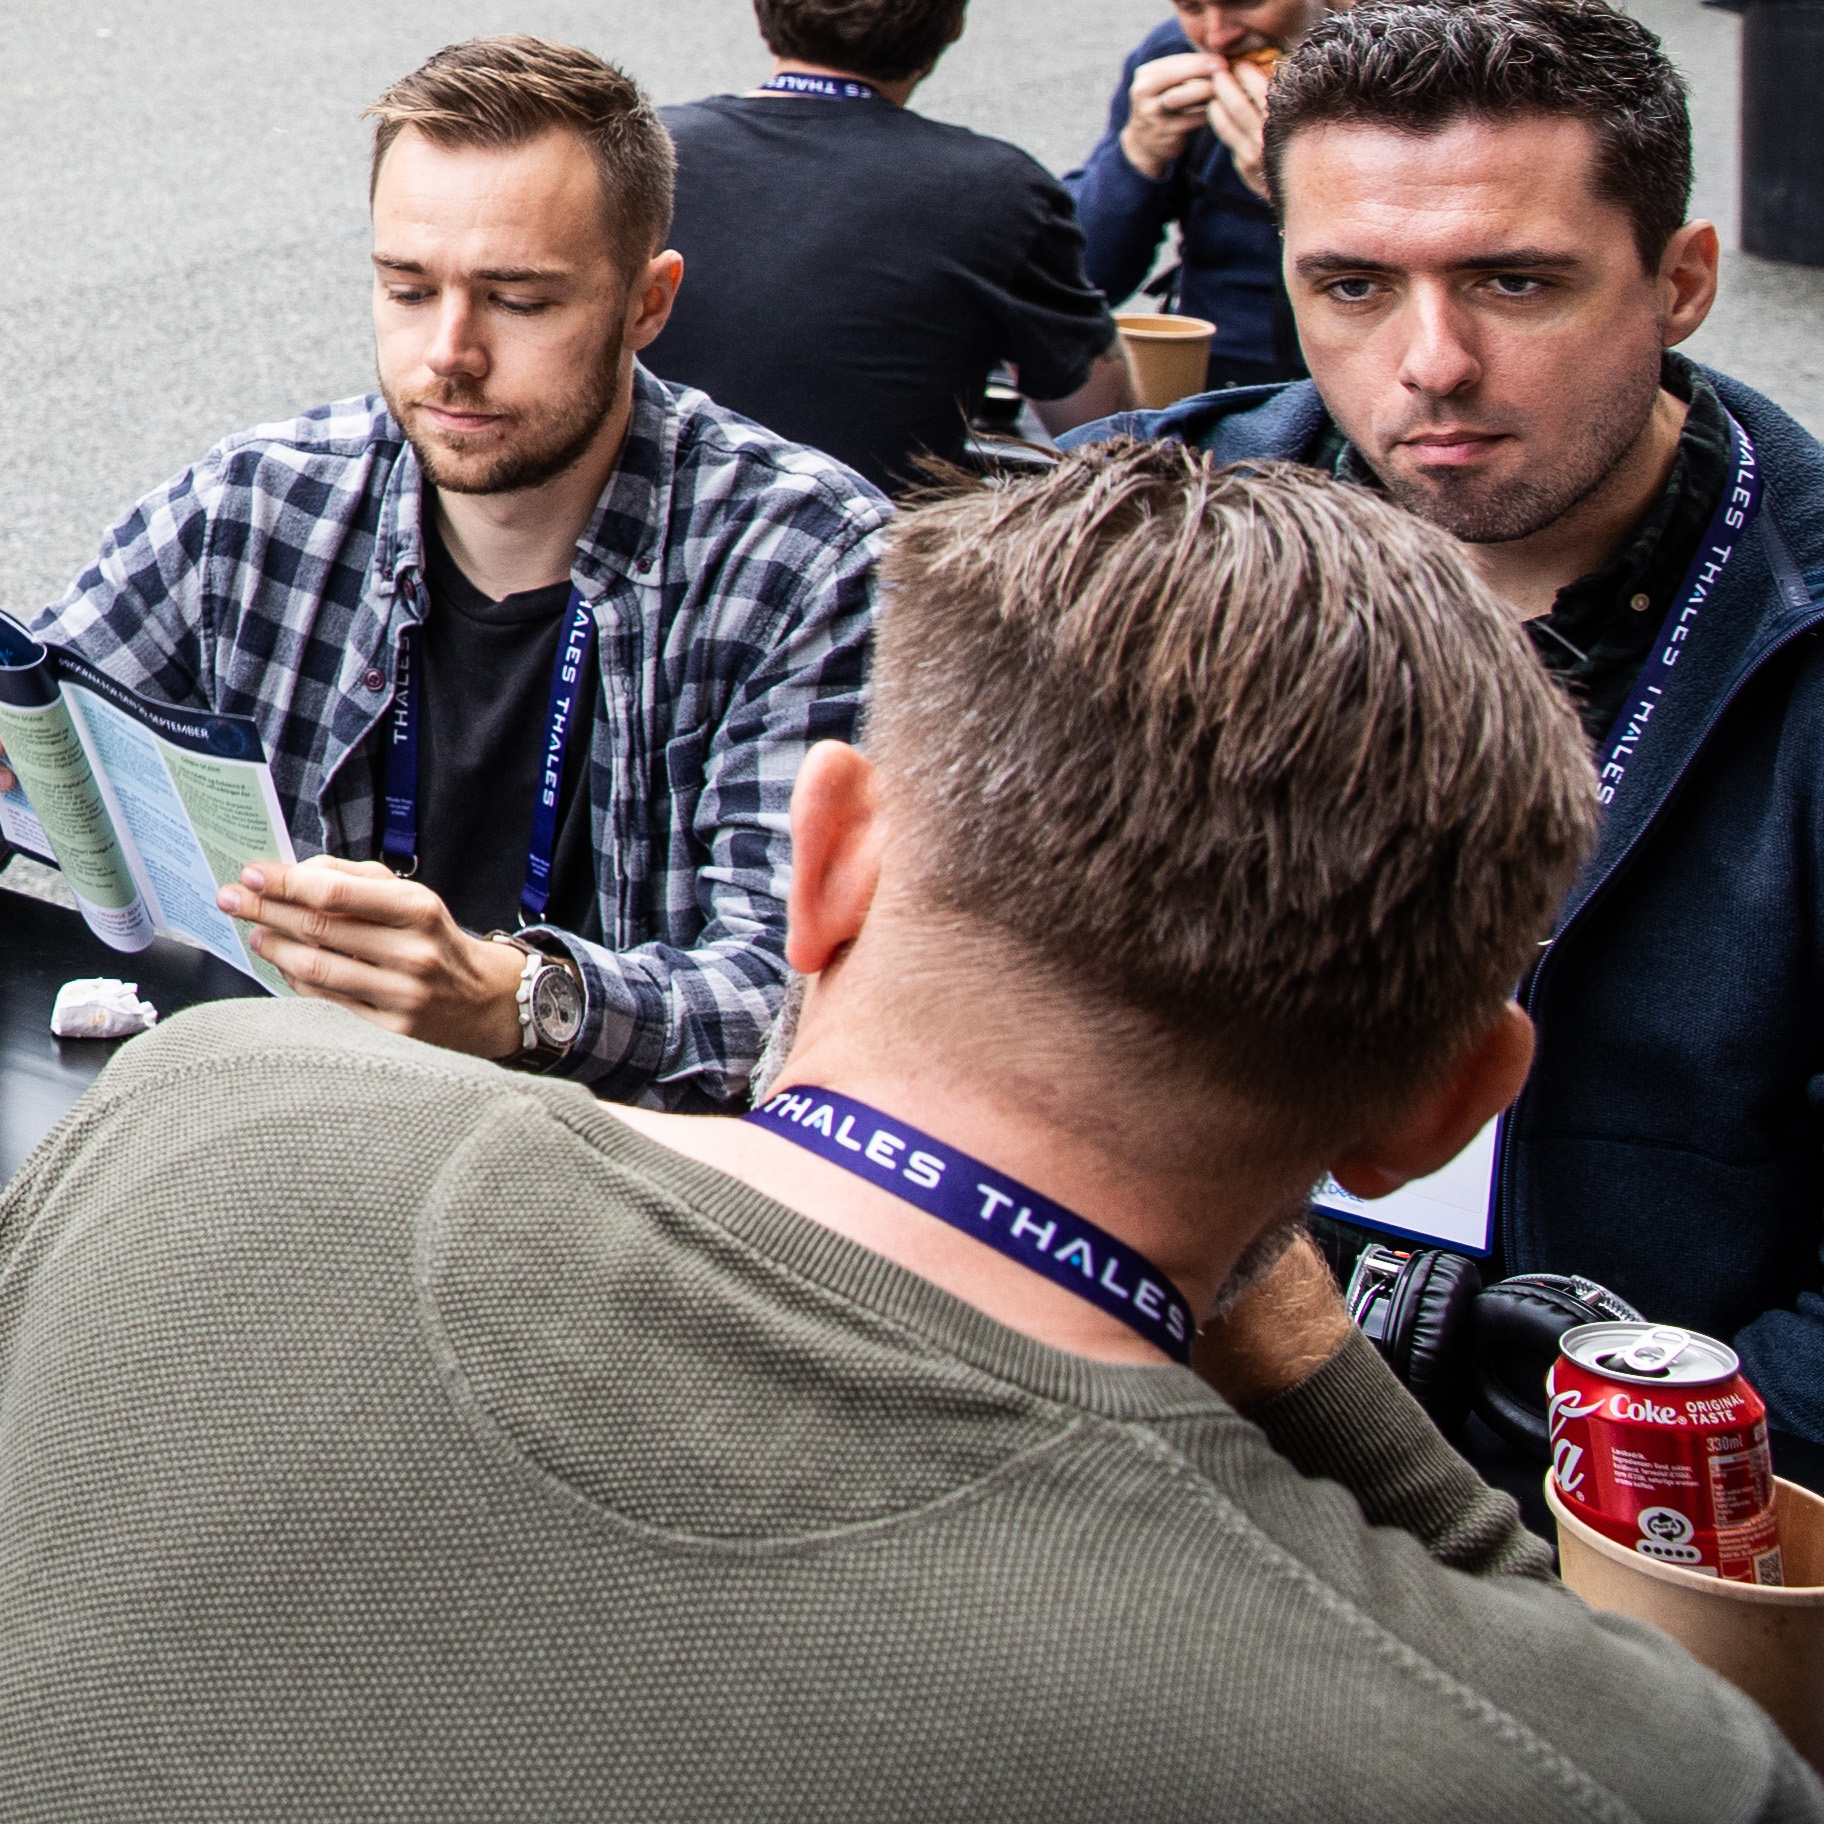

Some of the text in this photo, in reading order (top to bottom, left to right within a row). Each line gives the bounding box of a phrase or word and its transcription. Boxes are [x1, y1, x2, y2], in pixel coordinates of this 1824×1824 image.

[1724, 429, 1755, 530] HALES
[1661, 544, 1733, 667] THALES
[393, 635, 411, 746] THALES
[542, 599, 593, 808] HALES THALES
[763, 1092, 1186, 1344] THALES THALES
[1609, 1393, 1746, 1425] Coke ORIGINAL
[1690, 1409, 1737, 1426] TASTE
[1706, 1434, 1744, 1453] 330ml
